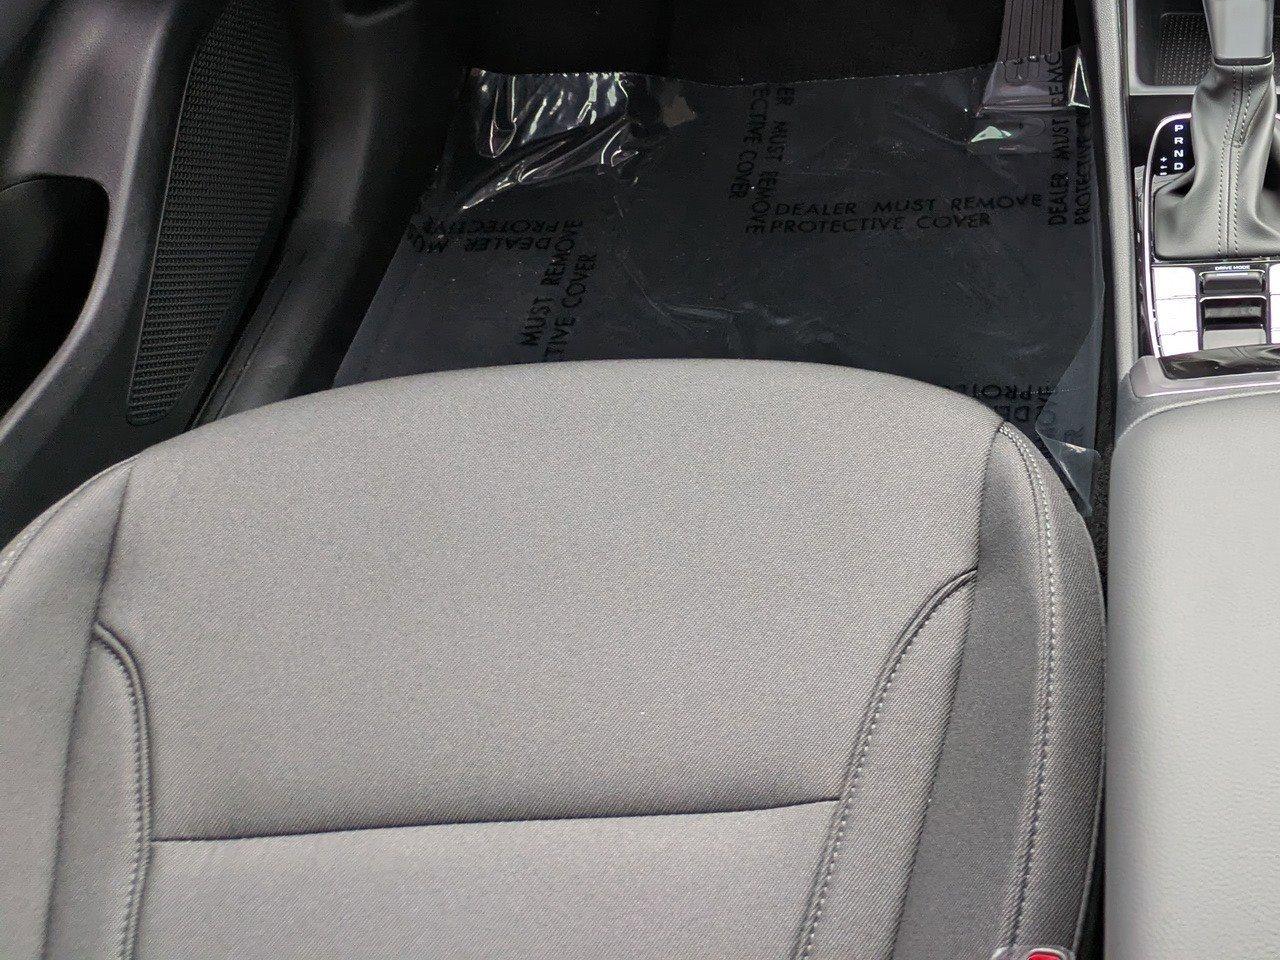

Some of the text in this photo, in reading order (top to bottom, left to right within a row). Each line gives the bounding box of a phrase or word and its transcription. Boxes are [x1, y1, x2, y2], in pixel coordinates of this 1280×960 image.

[1174, 124, 1184, 132] P
[1174, 137, 1184, 145] R
[1173, 149, 1184, 158] N
[1173, 162, 1184, 171] D
[775, 201, 858, 217] DEALER
[872, 198, 936, 213] MUST
[915, 211, 993, 230] COVER
